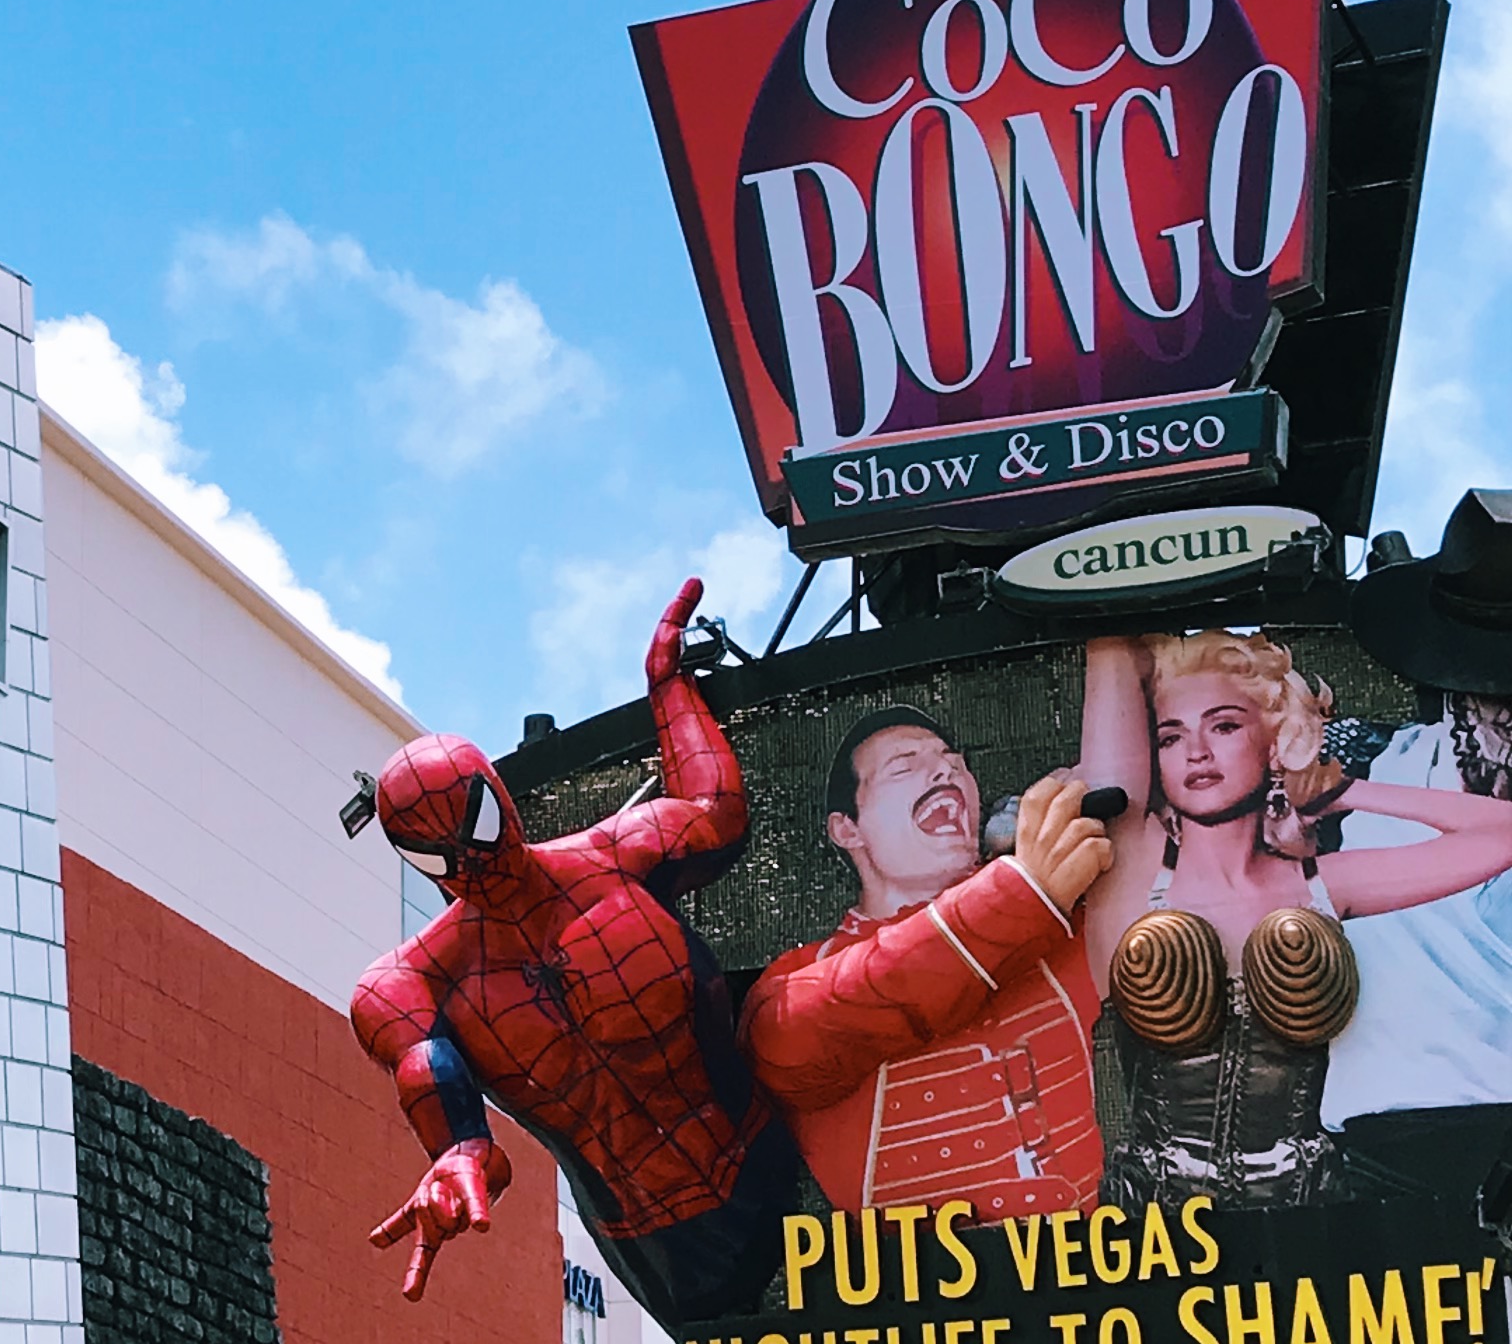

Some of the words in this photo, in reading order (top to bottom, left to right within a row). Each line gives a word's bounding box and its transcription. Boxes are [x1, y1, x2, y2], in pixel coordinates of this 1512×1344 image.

[742, 64, 1307, 460] BONGO
[832, 457, 979, 508] Show
[998, 432, 1049, 481] &
[1066, 409, 1226, 470] Disco
[1052, 518, 1251, 580] cancun
[783, 1200, 977, 1311] PUTS
[1003, 1196, 1220, 1292] VEGAS
